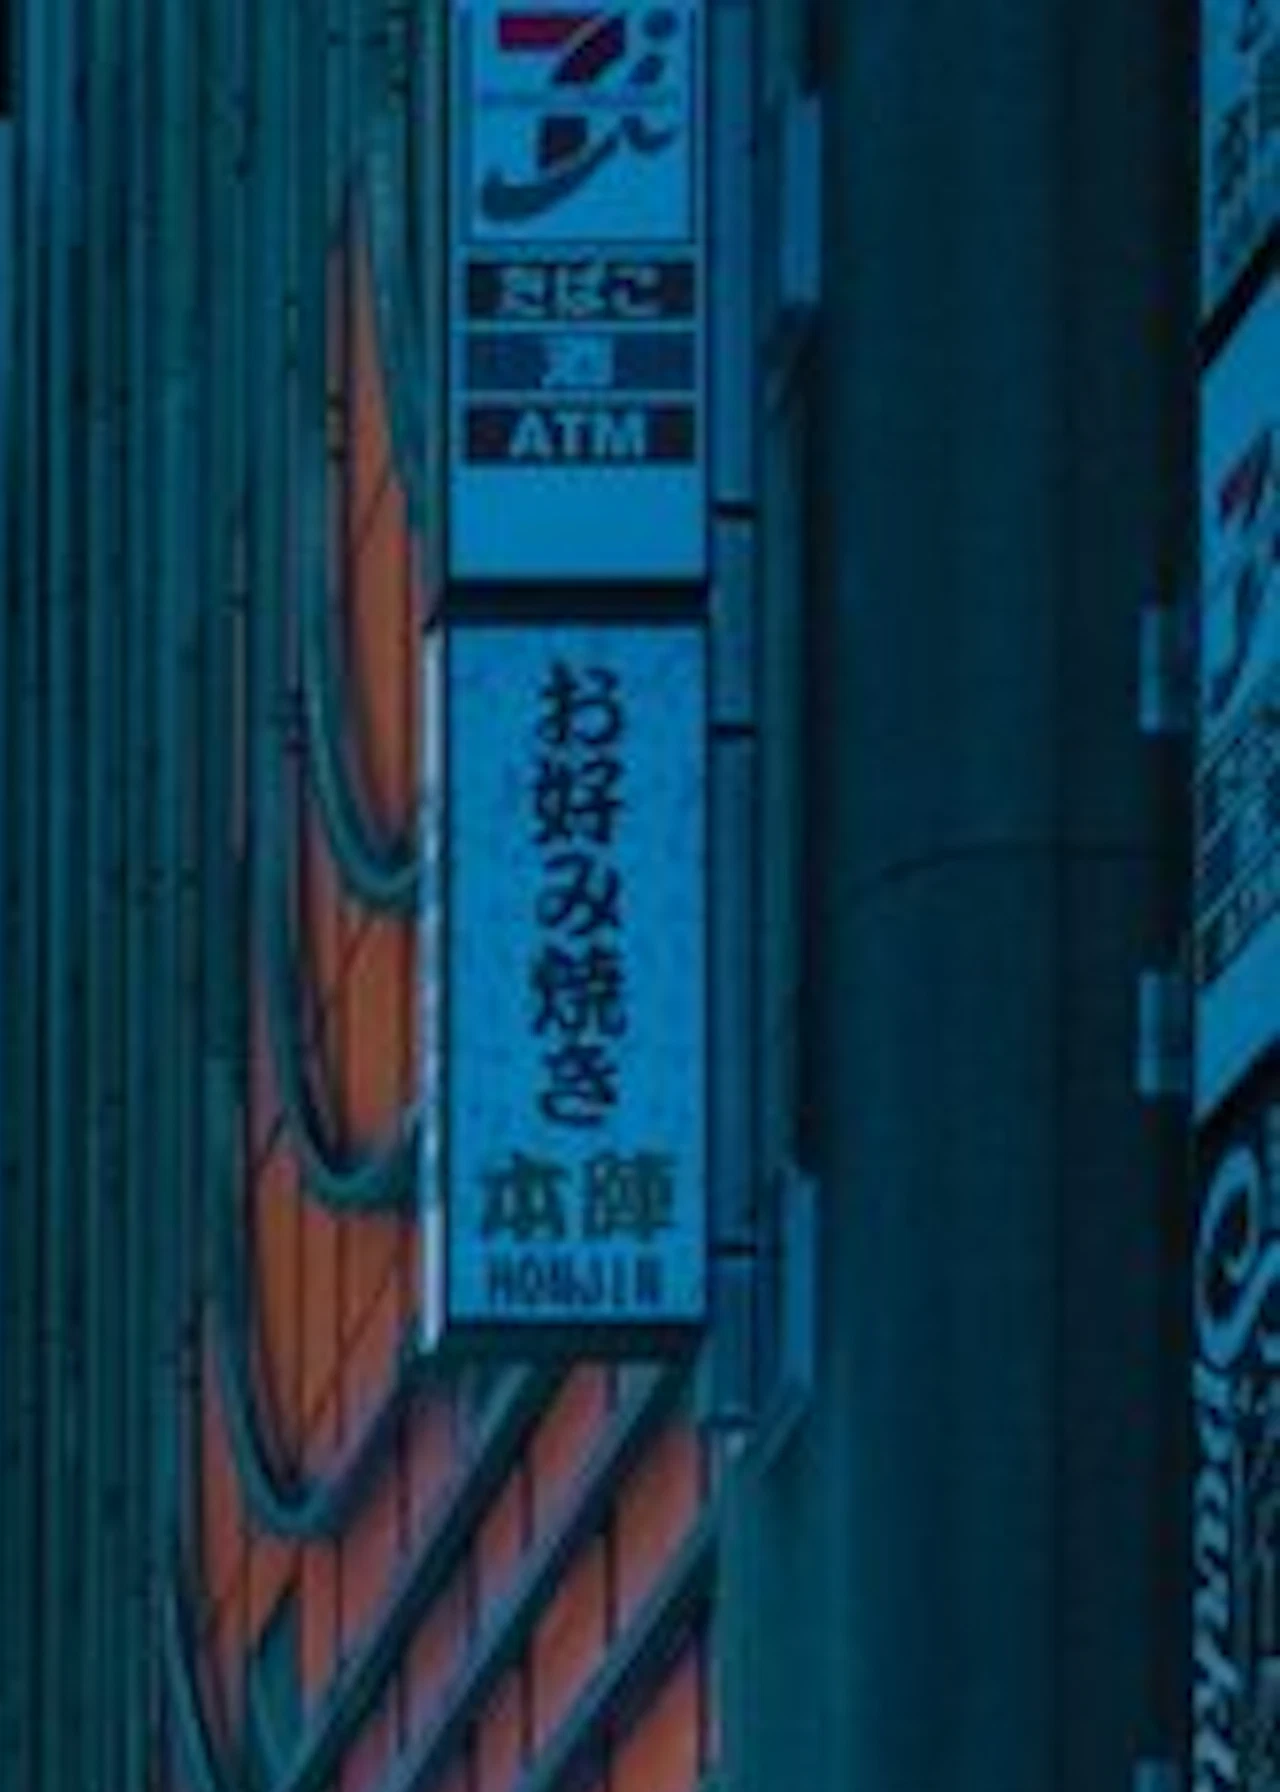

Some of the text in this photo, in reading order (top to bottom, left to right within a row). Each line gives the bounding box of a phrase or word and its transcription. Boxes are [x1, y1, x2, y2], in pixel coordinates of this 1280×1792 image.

[509, 411, 646, 459] ATM
[529, 660, 628, 1128] お好み焼き
